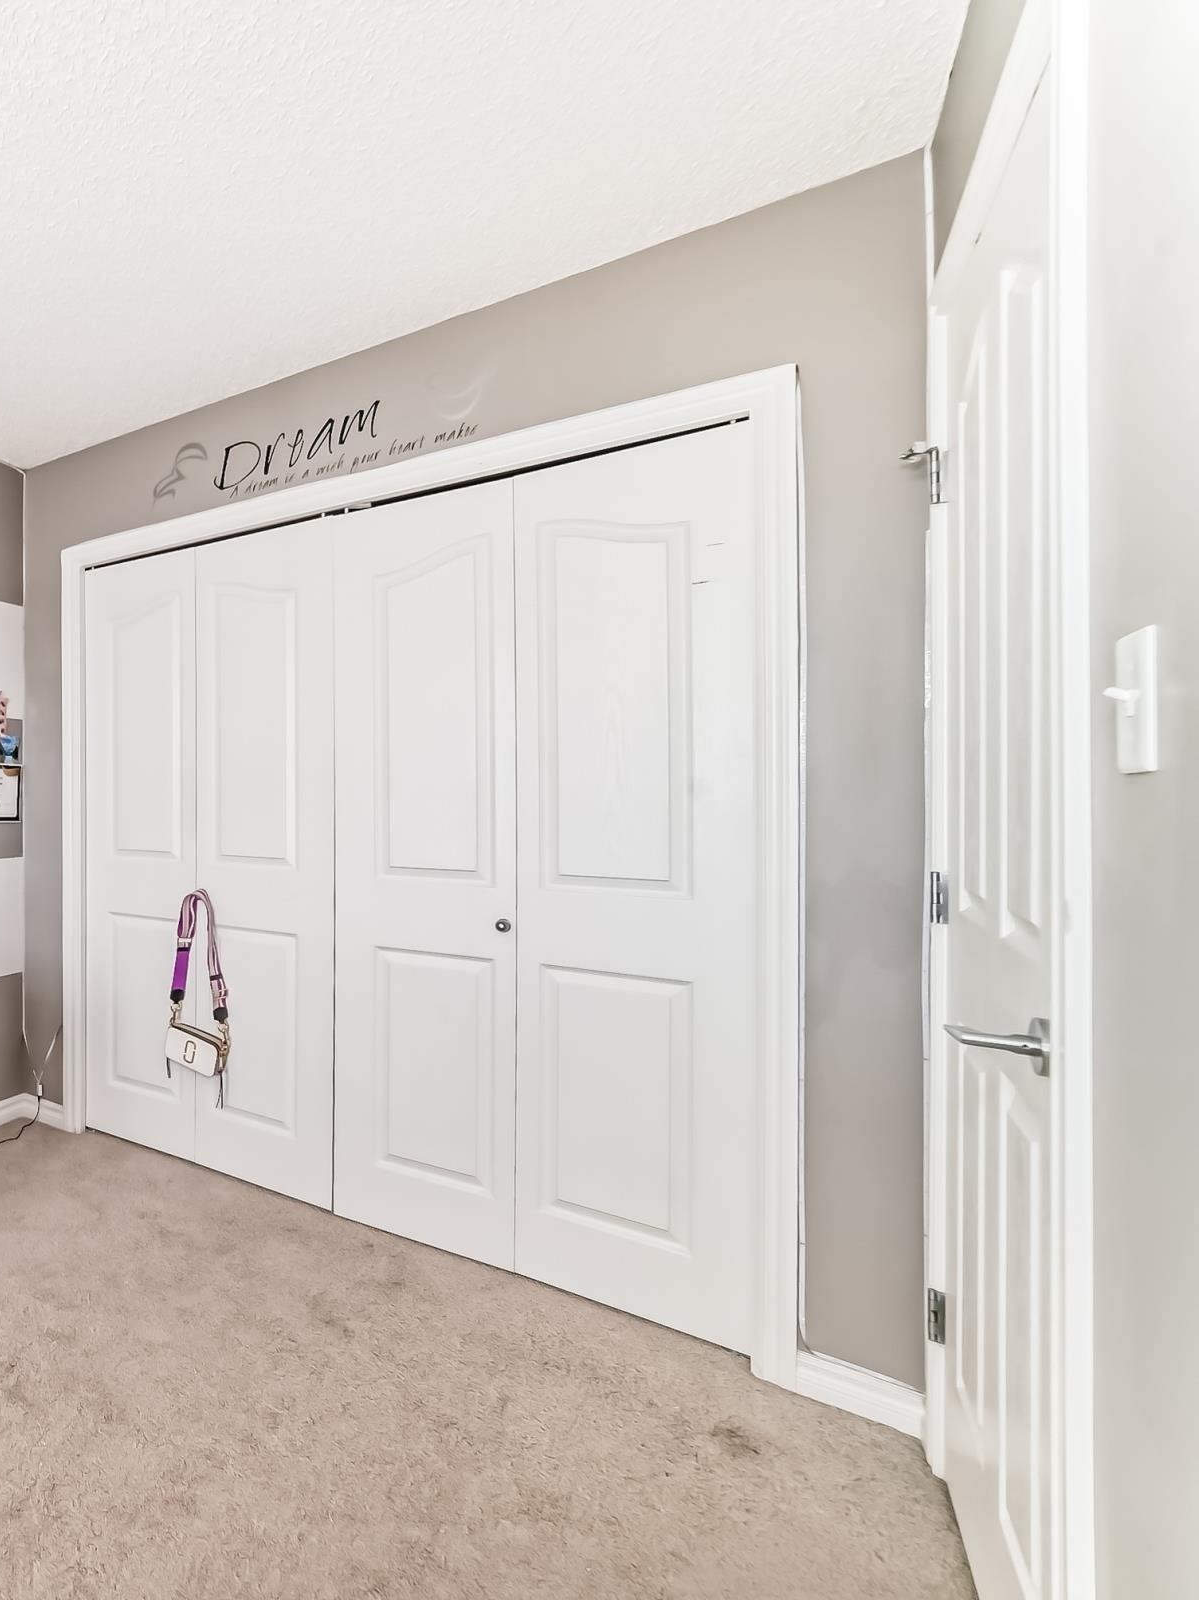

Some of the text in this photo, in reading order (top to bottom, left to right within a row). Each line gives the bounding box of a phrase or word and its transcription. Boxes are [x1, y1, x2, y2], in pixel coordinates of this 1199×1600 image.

[213, 399, 381, 491] Dream
[229, 485, 239, 499] A
[245, 477, 278, 494] dream
[302, 469, 310, 479] a
[316, 453, 345, 476] wish
[349, 449, 382, 473] your
[389, 435, 425, 456] heart
